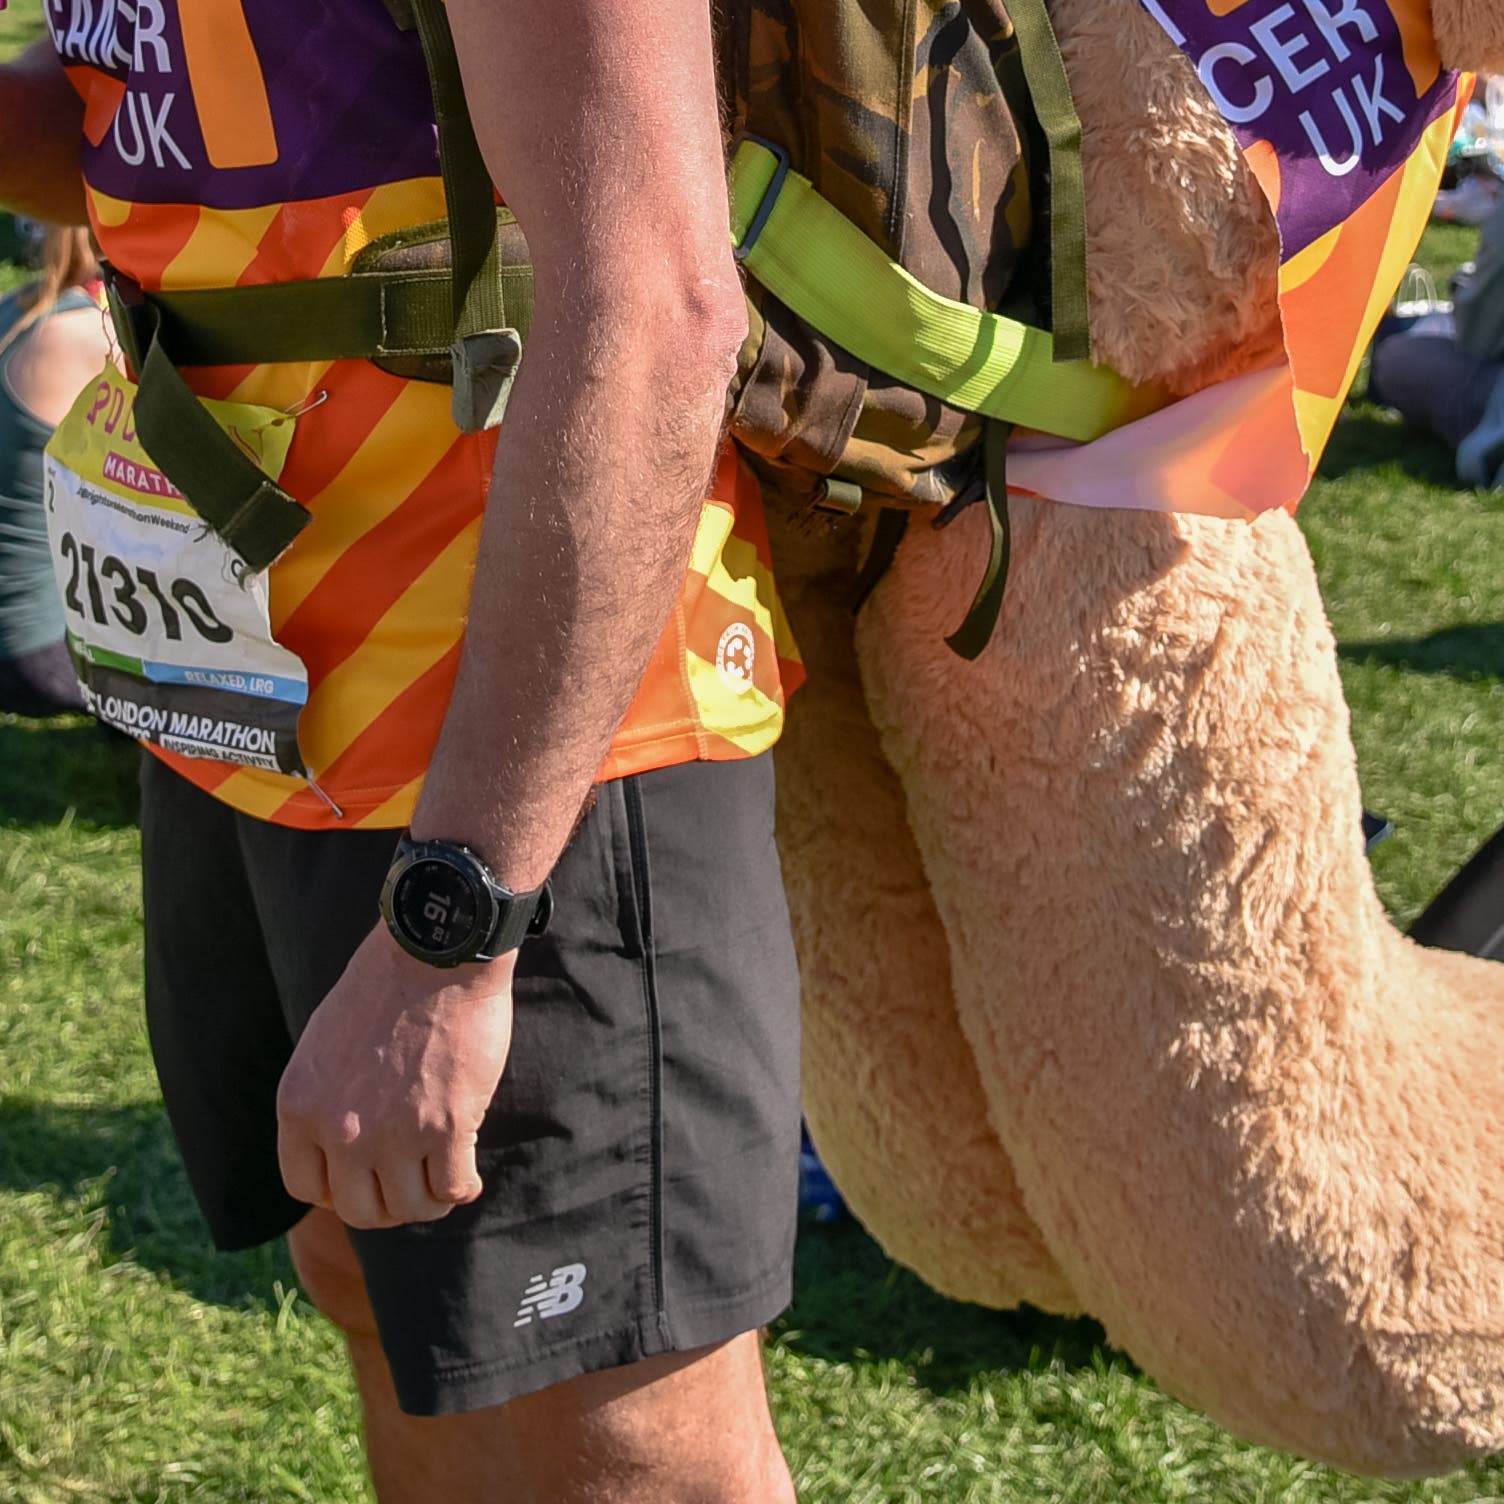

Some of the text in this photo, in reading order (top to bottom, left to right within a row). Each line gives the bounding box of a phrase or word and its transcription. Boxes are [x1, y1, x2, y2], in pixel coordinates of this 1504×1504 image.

[114, 91, 193, 170] UK
[1298, 53, 1406, 176] UK
[104, 455, 182, 496] MARATH
[249, 678, 275, 695] LRG
[96, 693, 167, 732] LONDON
[168, 711, 276, 754] MARATHON
